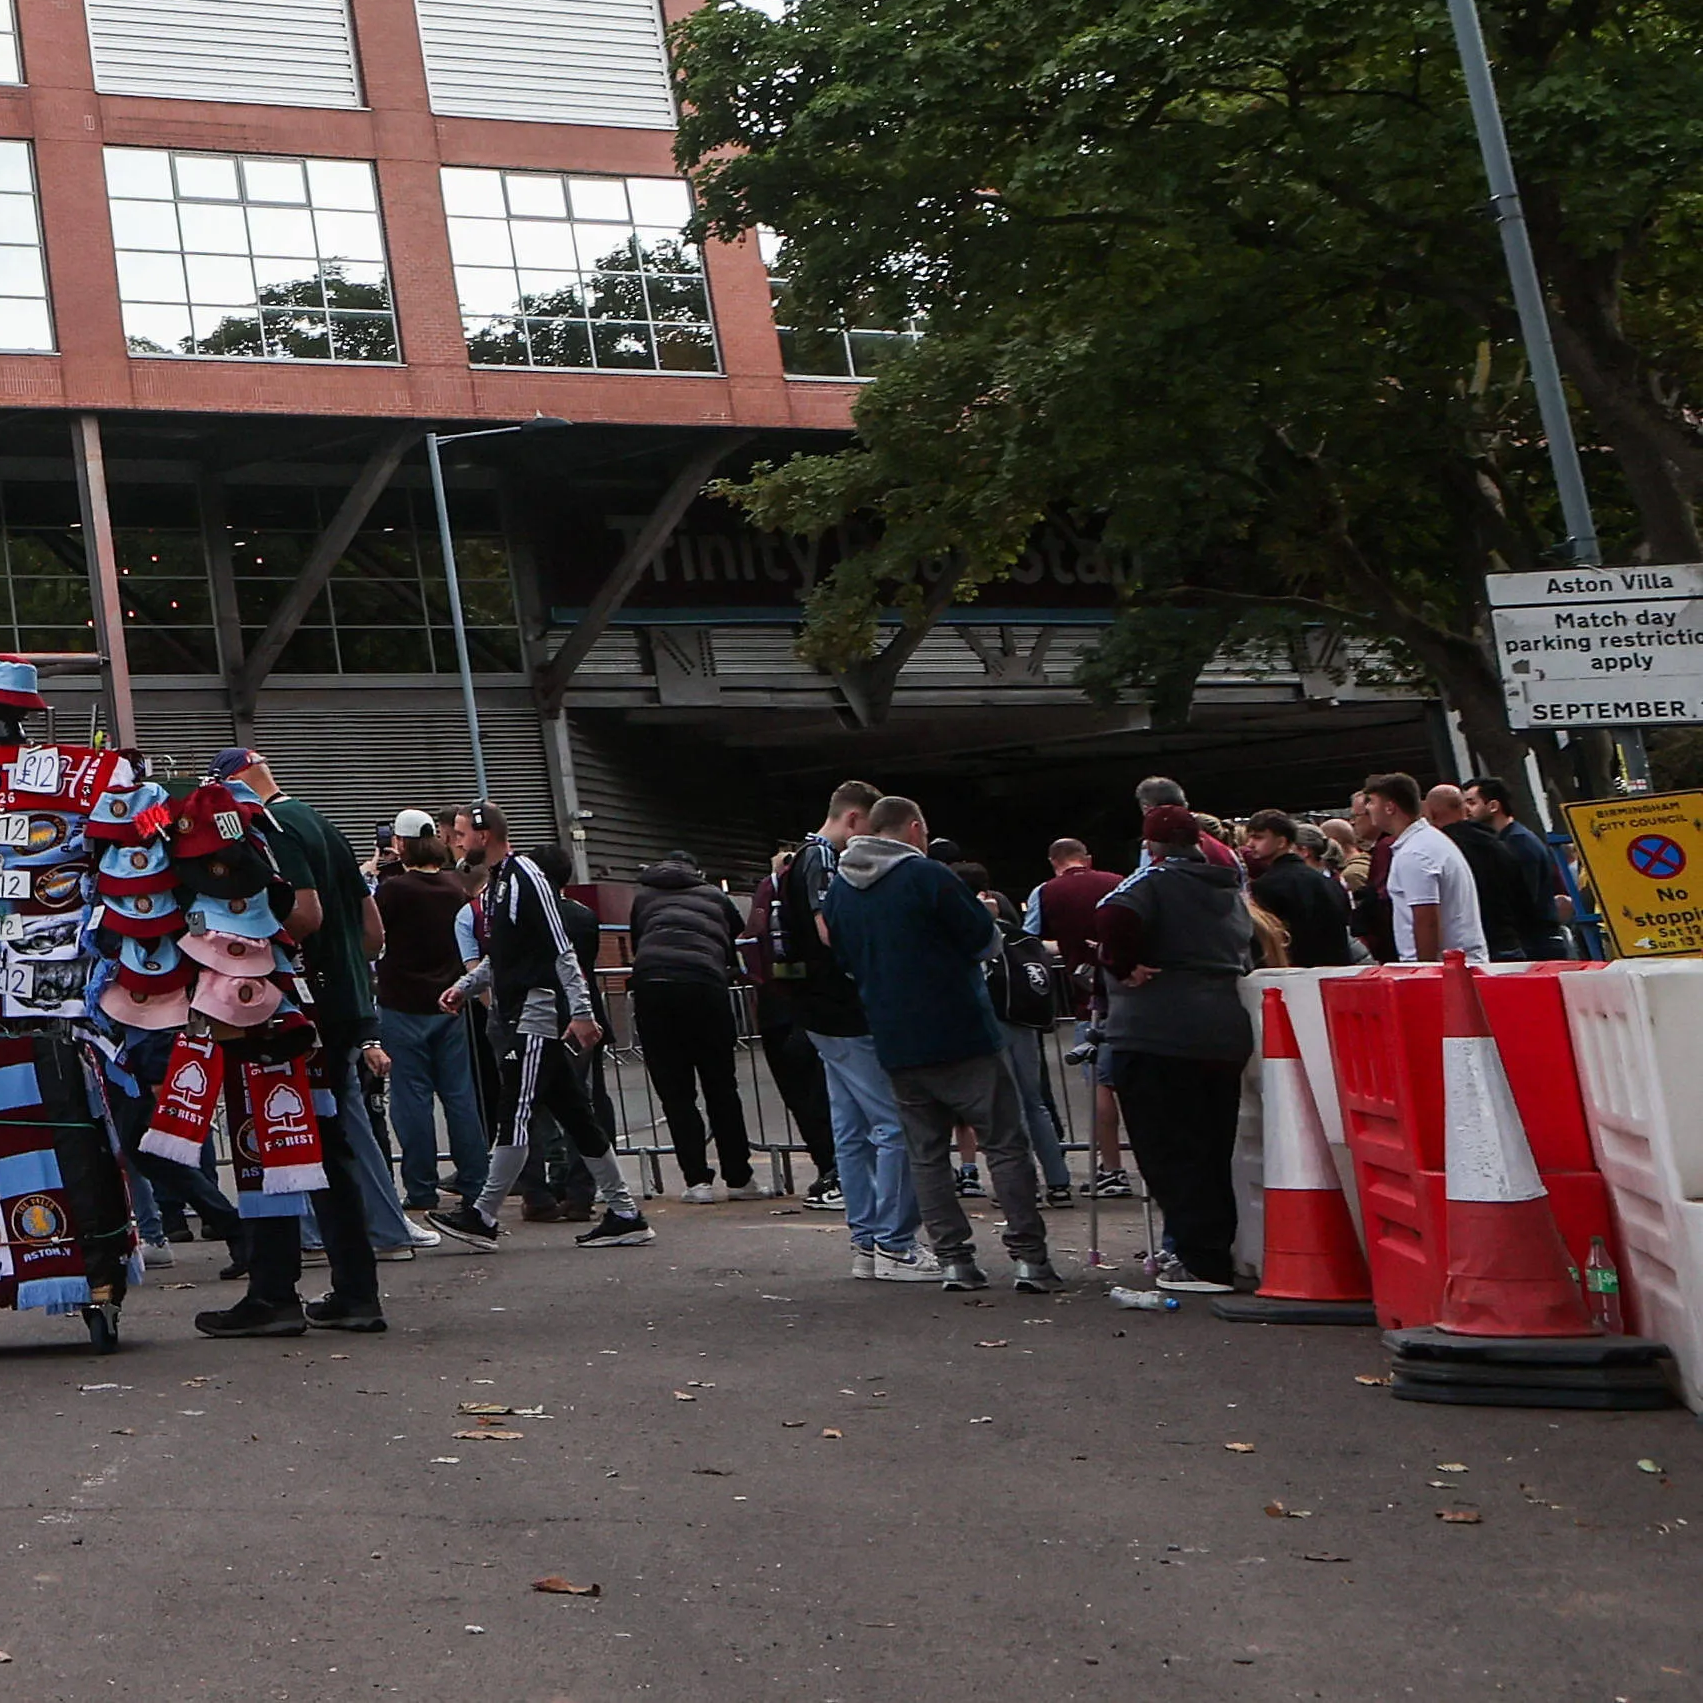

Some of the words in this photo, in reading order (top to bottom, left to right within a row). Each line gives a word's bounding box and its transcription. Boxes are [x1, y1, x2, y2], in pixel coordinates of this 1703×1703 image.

[1546, 577, 1613, 595] Aston
[1620, 573, 1674, 592] Villa
[1554, 610, 1628, 630] Match
[1636, 609, 1677, 628] day
[1505, 634, 1591, 656] parking
[1591, 652, 1654, 673] apply
[1533, 700, 1687, 721] SEPTEMBER
[16, 754, 54, 789] £12
[1596, 801, 1681, 819] BIRMINGHAM
[1598, 820, 1626, 832] CITY
[1629, 814, 1688, 828] COUNCIL
[1656, 886, 1690, 902] No
[1648, 938, 1676, 949] Sun
[1680, 936, 1695, 947] 13
[1658, 926, 1683, 938] Sat
